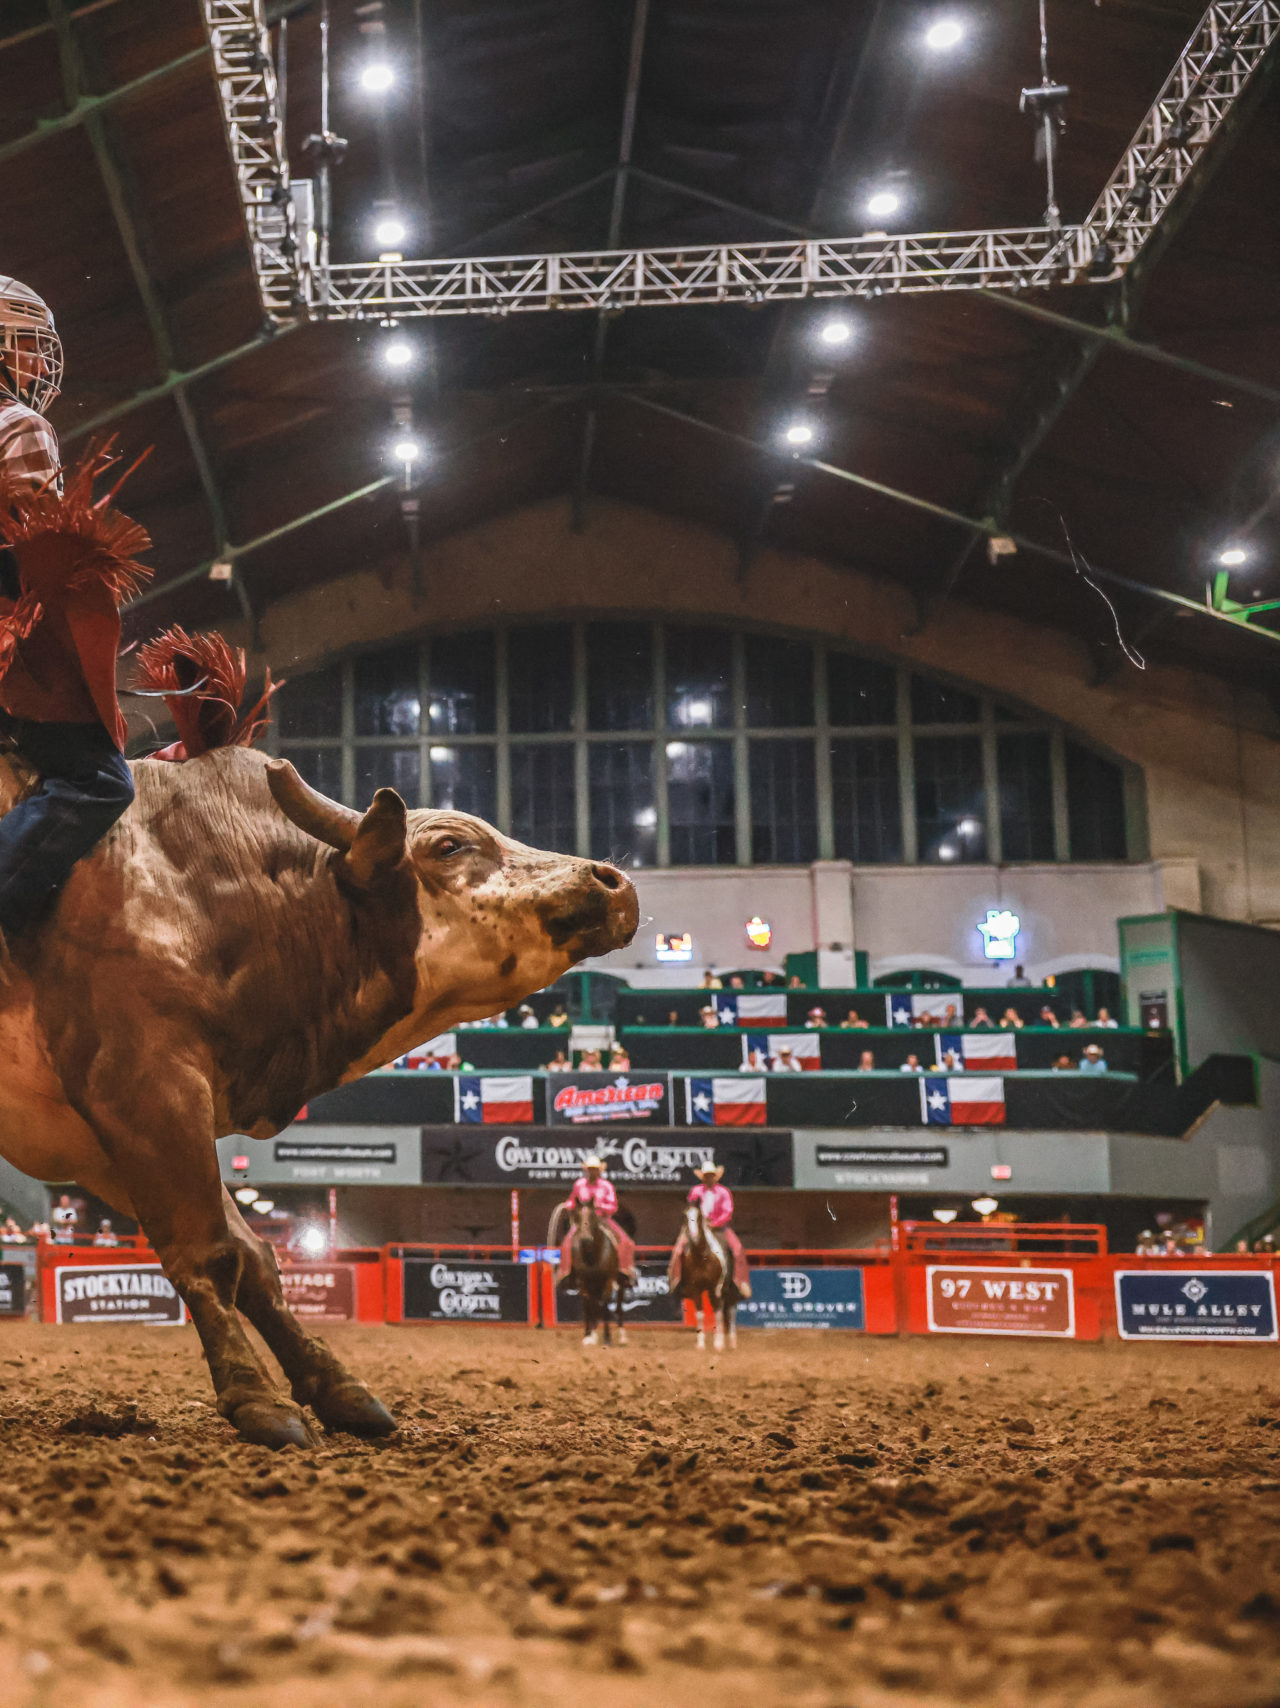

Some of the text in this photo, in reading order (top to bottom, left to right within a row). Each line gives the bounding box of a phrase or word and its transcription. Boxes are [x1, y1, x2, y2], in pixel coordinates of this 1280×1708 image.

[554, 1083, 664, 1112] American
[63, 1273, 176, 1303] STOCKYARDS
[940, 1278, 1060, 1301] 97 WEST
[90, 1299, 150, 1312] STATION
[1131, 1303, 1262, 1317] MULE ALLEY
